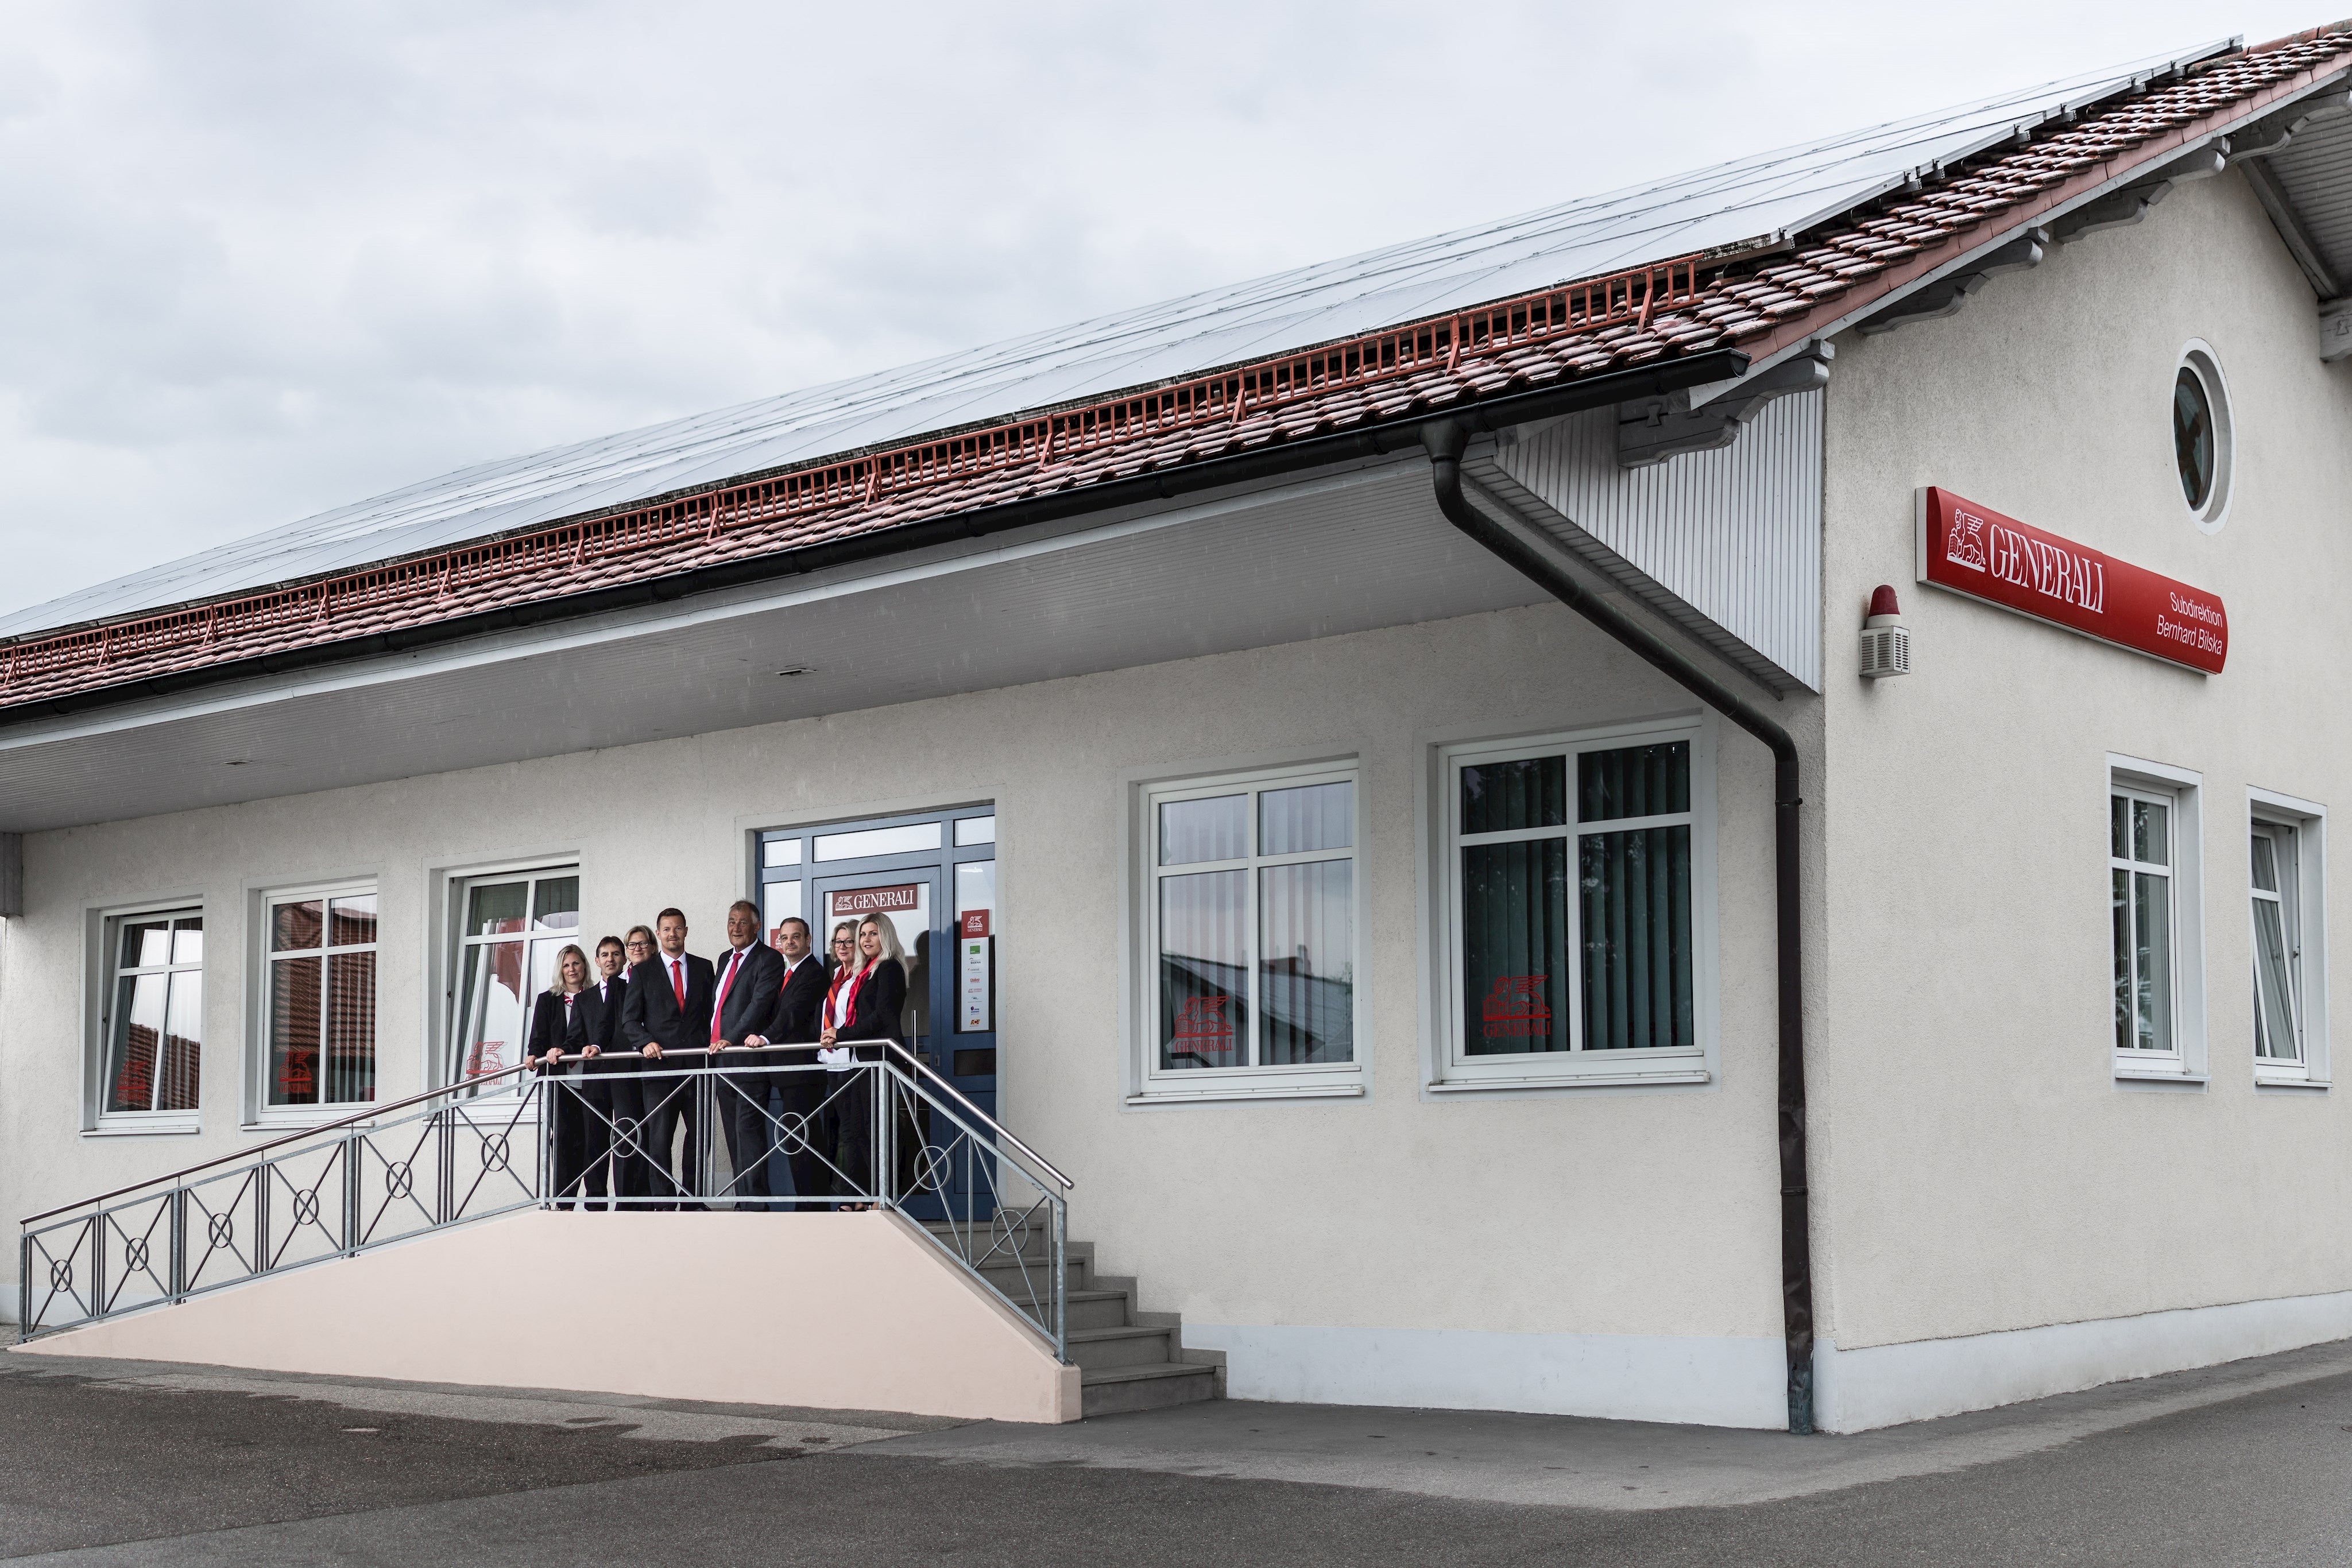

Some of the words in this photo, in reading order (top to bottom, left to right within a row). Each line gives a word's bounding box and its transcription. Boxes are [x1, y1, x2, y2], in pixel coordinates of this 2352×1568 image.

[1990, 523, 2103, 614] GENERALI
[2170, 592, 2223, 628] Subdirektion
[2157, 614, 2196, 646] Bernhard
[2198, 629, 2222, 655] Bilska
[854, 890, 914, 909] GENERALI
[1483, 1021, 1552, 1037] GENERALI
[1175, 1038, 1232, 1053] GENERALI
[278, 1083, 312, 1093] GENERALI
